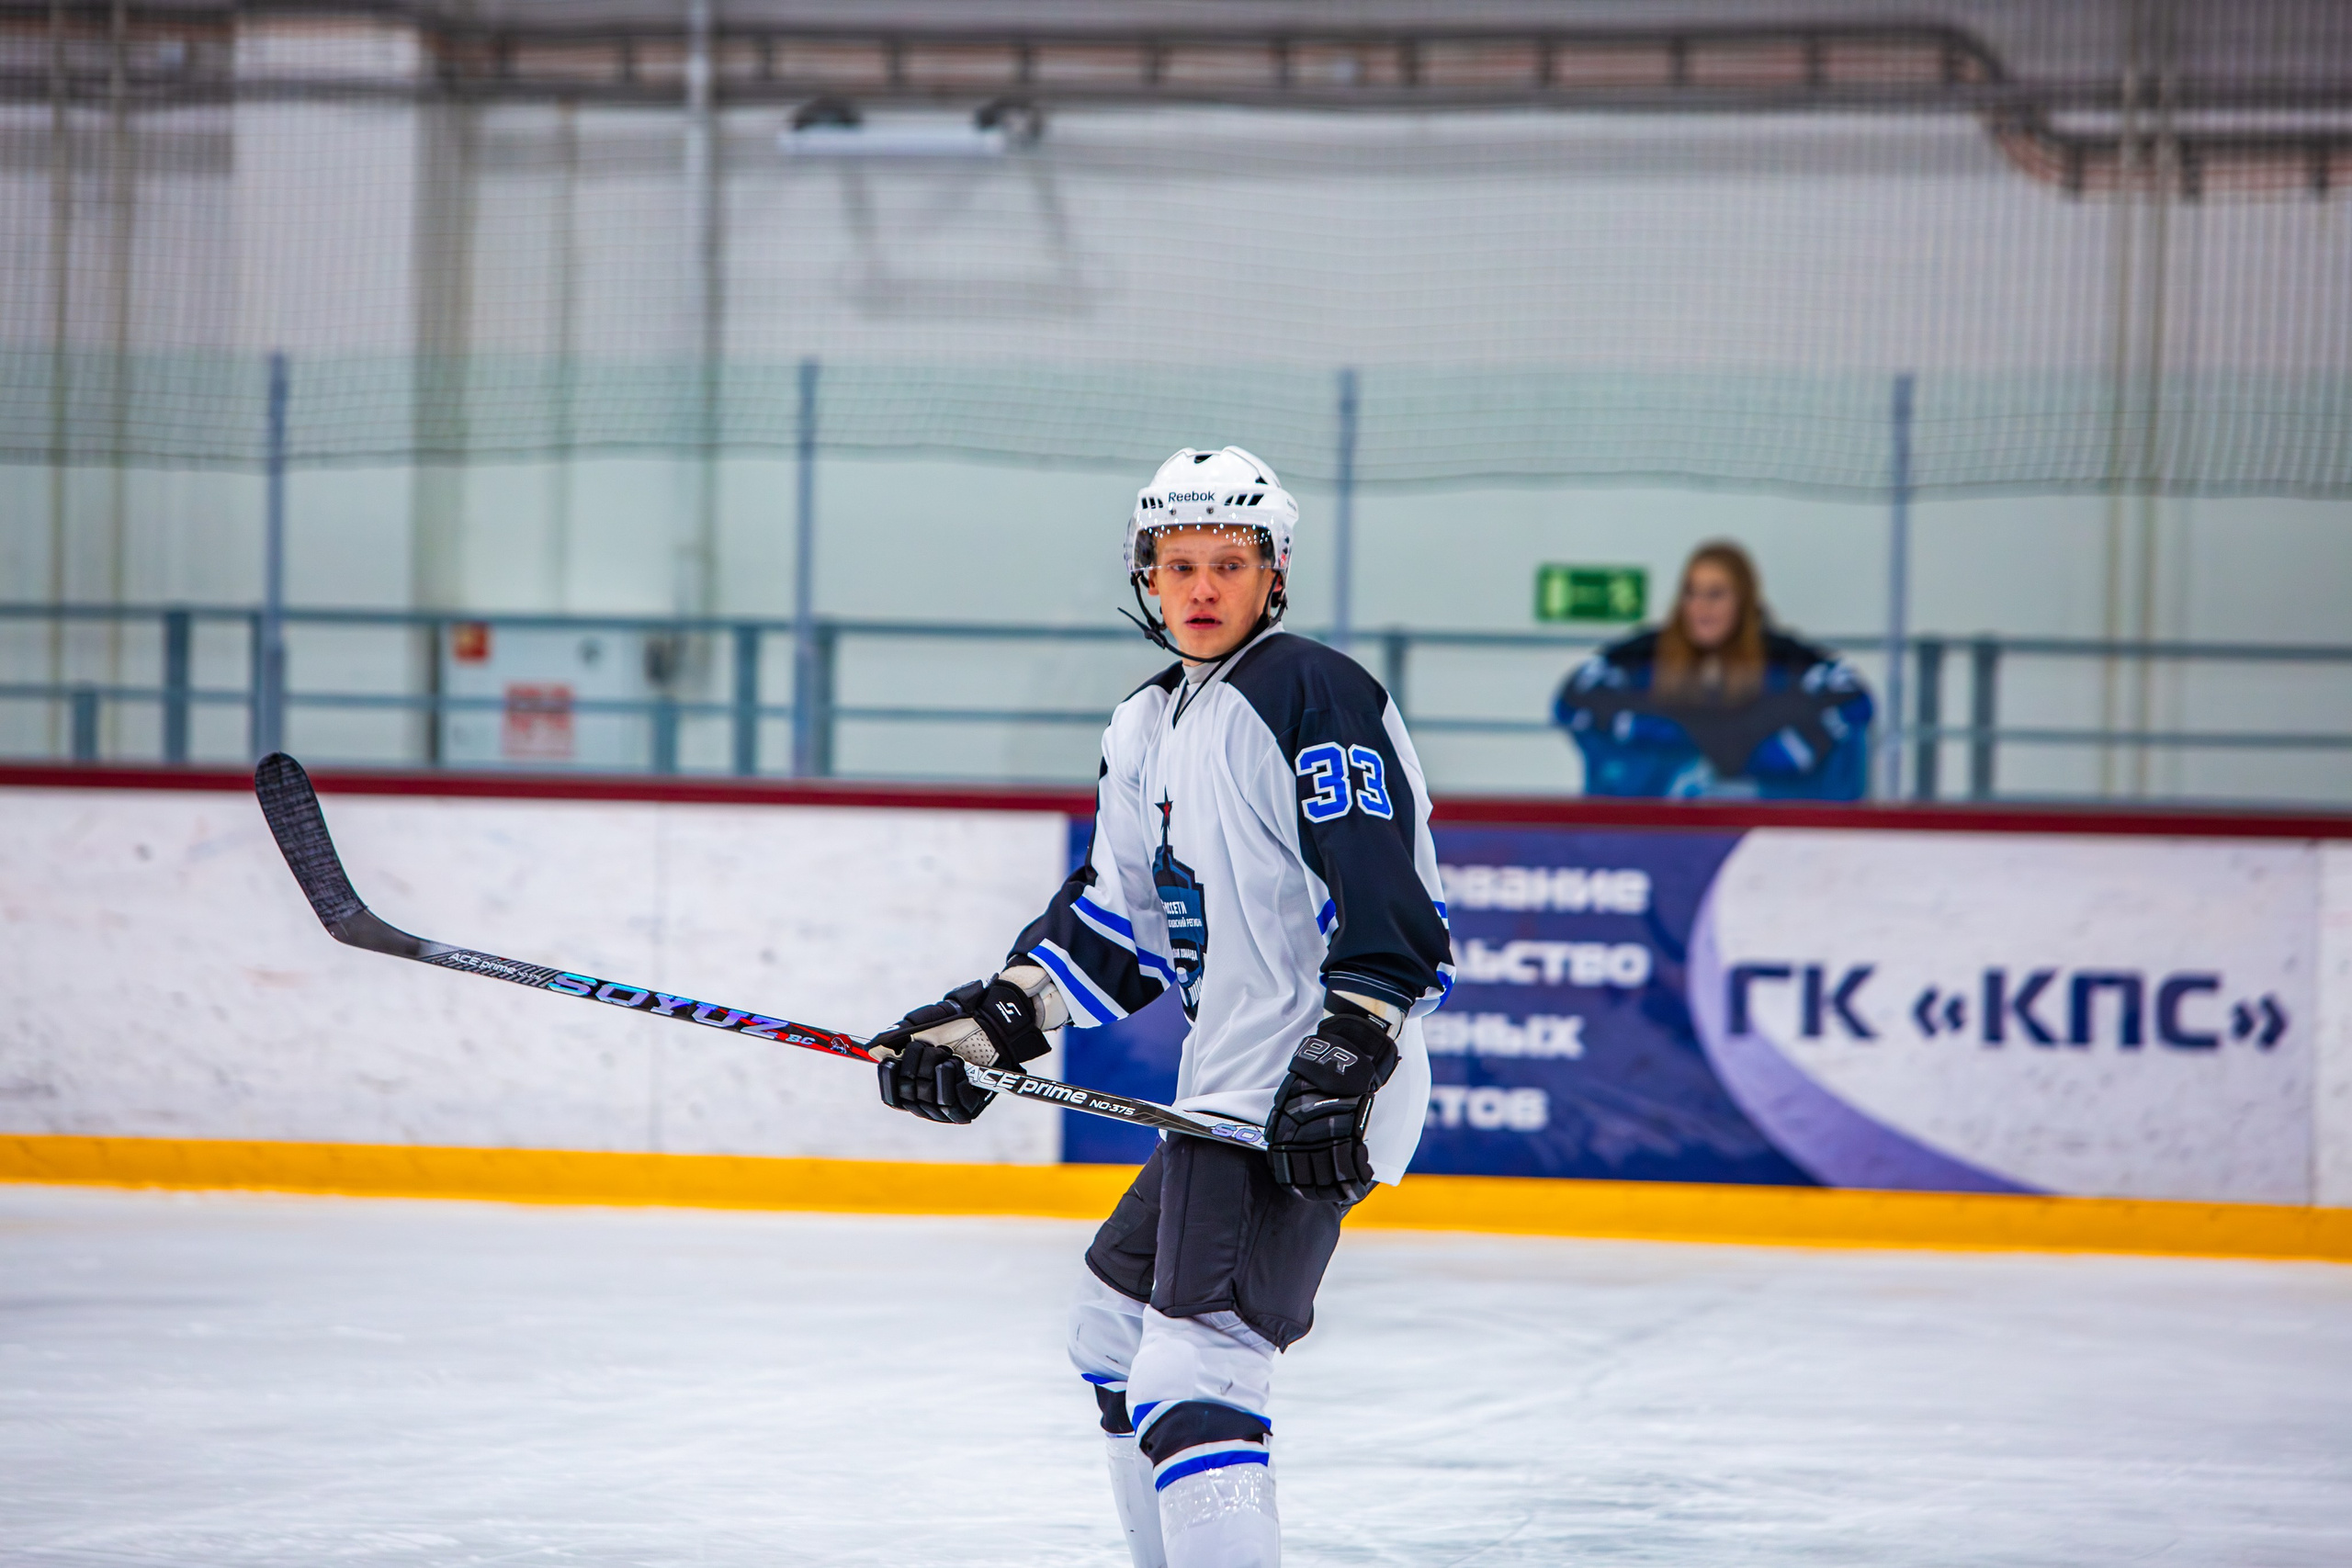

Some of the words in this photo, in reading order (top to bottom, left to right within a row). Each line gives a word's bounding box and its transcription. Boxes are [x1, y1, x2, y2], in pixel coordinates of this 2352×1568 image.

[1168, 491, 1216, 502] Reebok
[1295, 741, 1394, 823] 33
[1436, 864, 1652, 914] ование
[448, 953, 481, 966] ACE
[479, 961, 516, 975] prime
[547, 972, 790, 1040] SOYUZ
[1724, 959, 1880, 1041] ГК
[966, 1066, 1022, 1089] ACE
[1017, 1078, 1088, 1104] prime
[1211, 1122, 1270, 1146] SO
